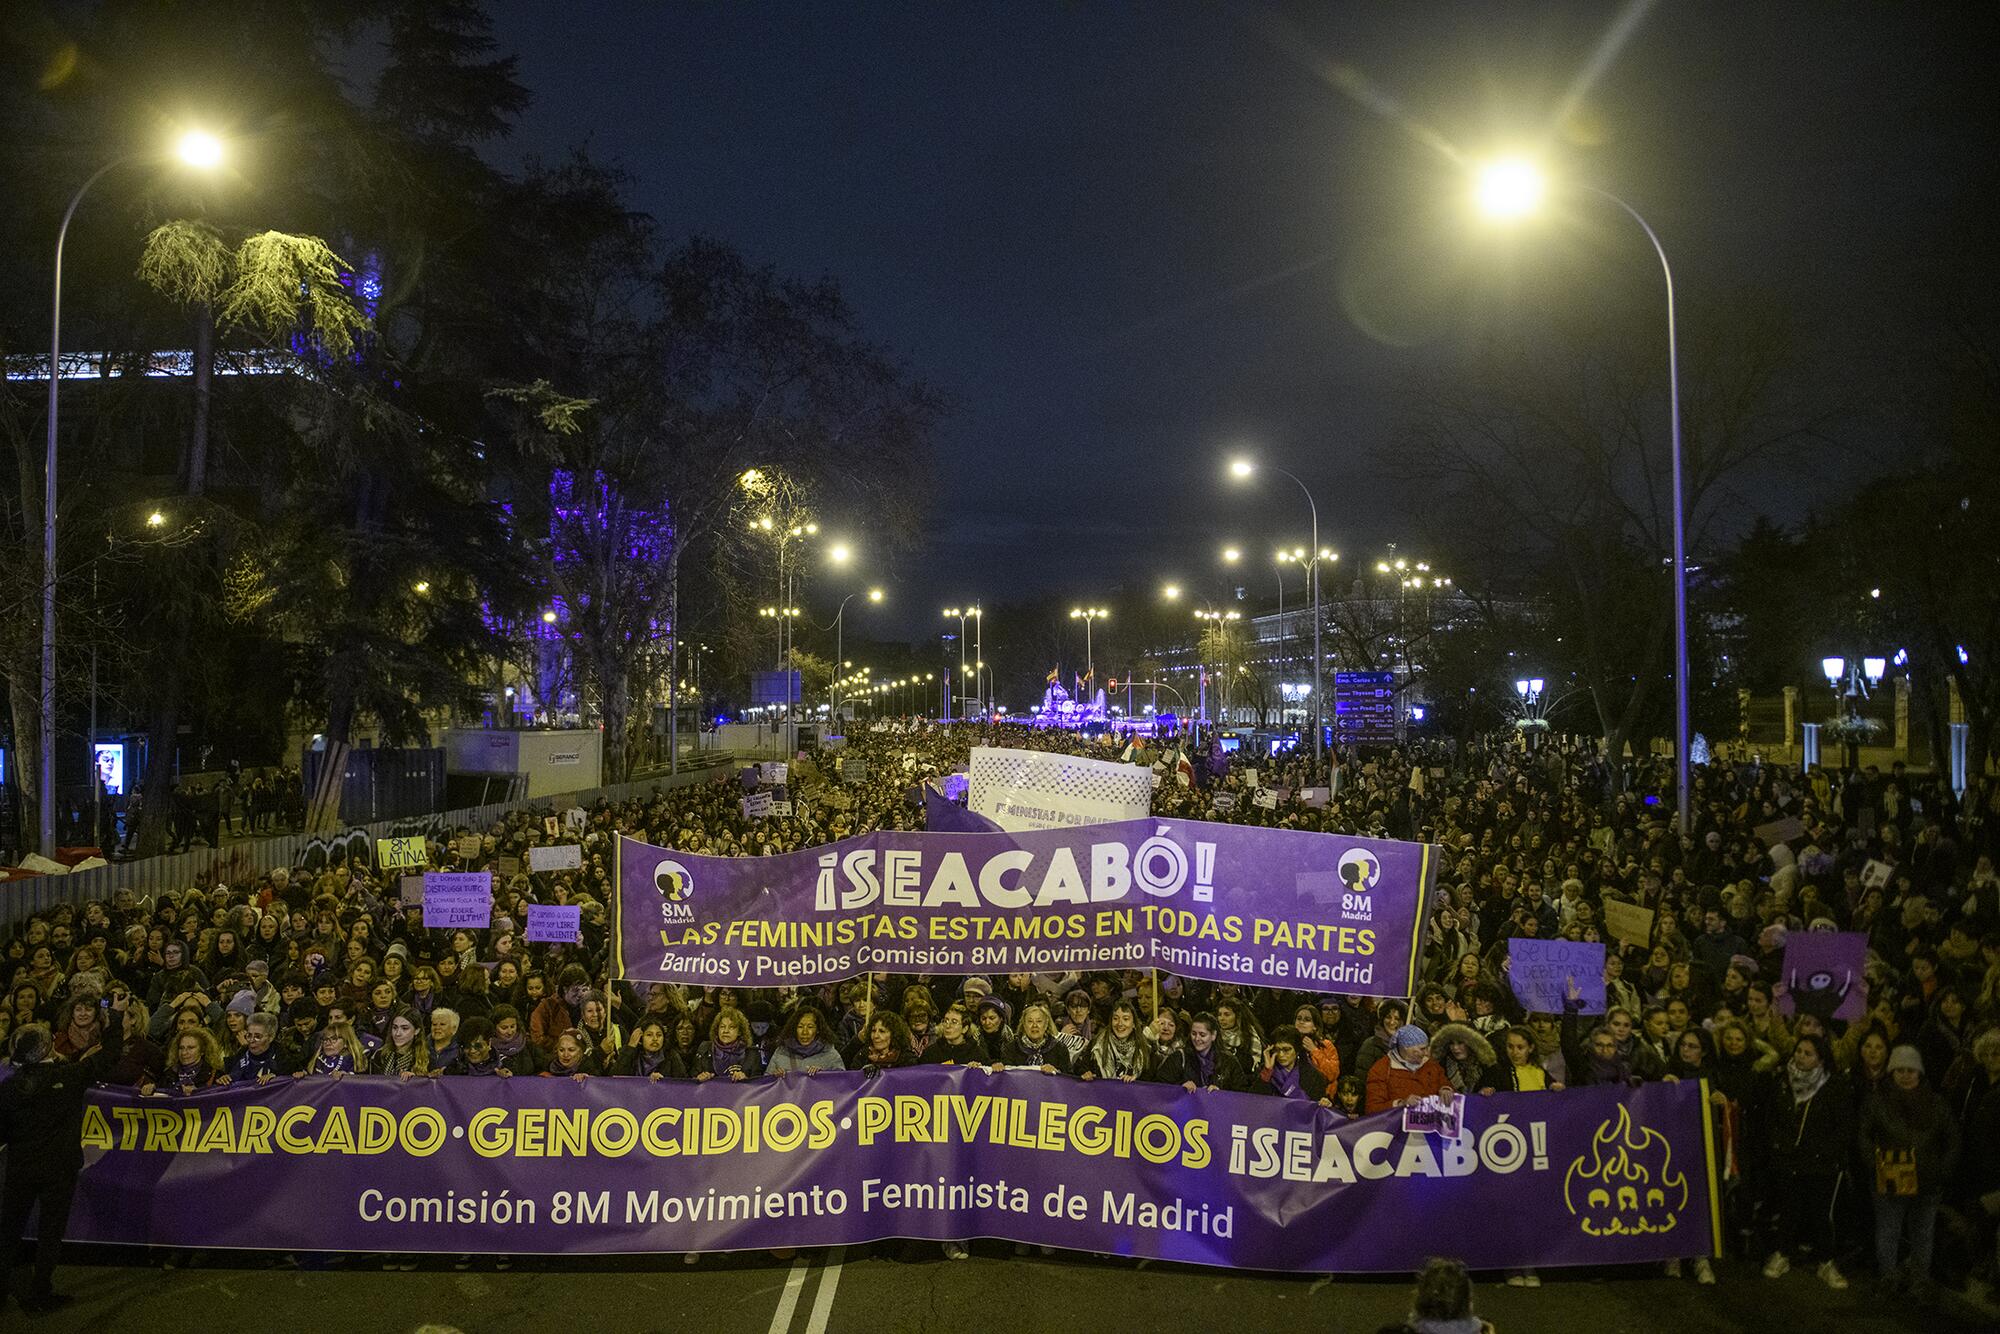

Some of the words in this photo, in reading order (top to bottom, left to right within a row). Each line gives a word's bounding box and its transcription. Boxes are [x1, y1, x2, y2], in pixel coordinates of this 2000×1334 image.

[1057, 812, 1082, 826] POR
[391, 838, 411, 852] 8M
[381, 849, 427, 867] LATINA
[662, 902, 693, 917] 8M
[1342, 893, 1371, 911] 8M
[664, 916, 695, 925] Madrid
[1342, 910, 1372, 921] Madrid
[660, 922, 721, 946] LAS
[724, 914, 918, 948] FEMINISTAS
[929, 915, 1085, 940] ESTAMOS
[1096, 909, 1133, 936] EN
[1142, 906, 1242, 941] TODAS
[1255, 920, 1376, 955] PARTES
[660, 952, 730, 975] Barrios
[737, 959, 749, 981] y
[757, 950, 850, 977] Pueblos
[857, 945, 964, 965] Comisión
[972, 947, 1008, 965] 8M
[1015, 942, 1145, 964] Movimiento
[1151, 938, 1254, 975] Feminista
[1261, 954, 1288, 976] de
[1296, 958, 1374, 985] Madrid
[81, 1105, 447, 1157] ATRIARCADO
[358, 1189, 536, 1224] Comisión
[551, 1191, 610, 1224] 8M
[626, 1186, 848, 1224] Movimiento
[863, 1176, 1029, 1213] Feminista
[1044, 1185, 1087, 1220] de
[1102, 1191, 1233, 1238] Madrid
